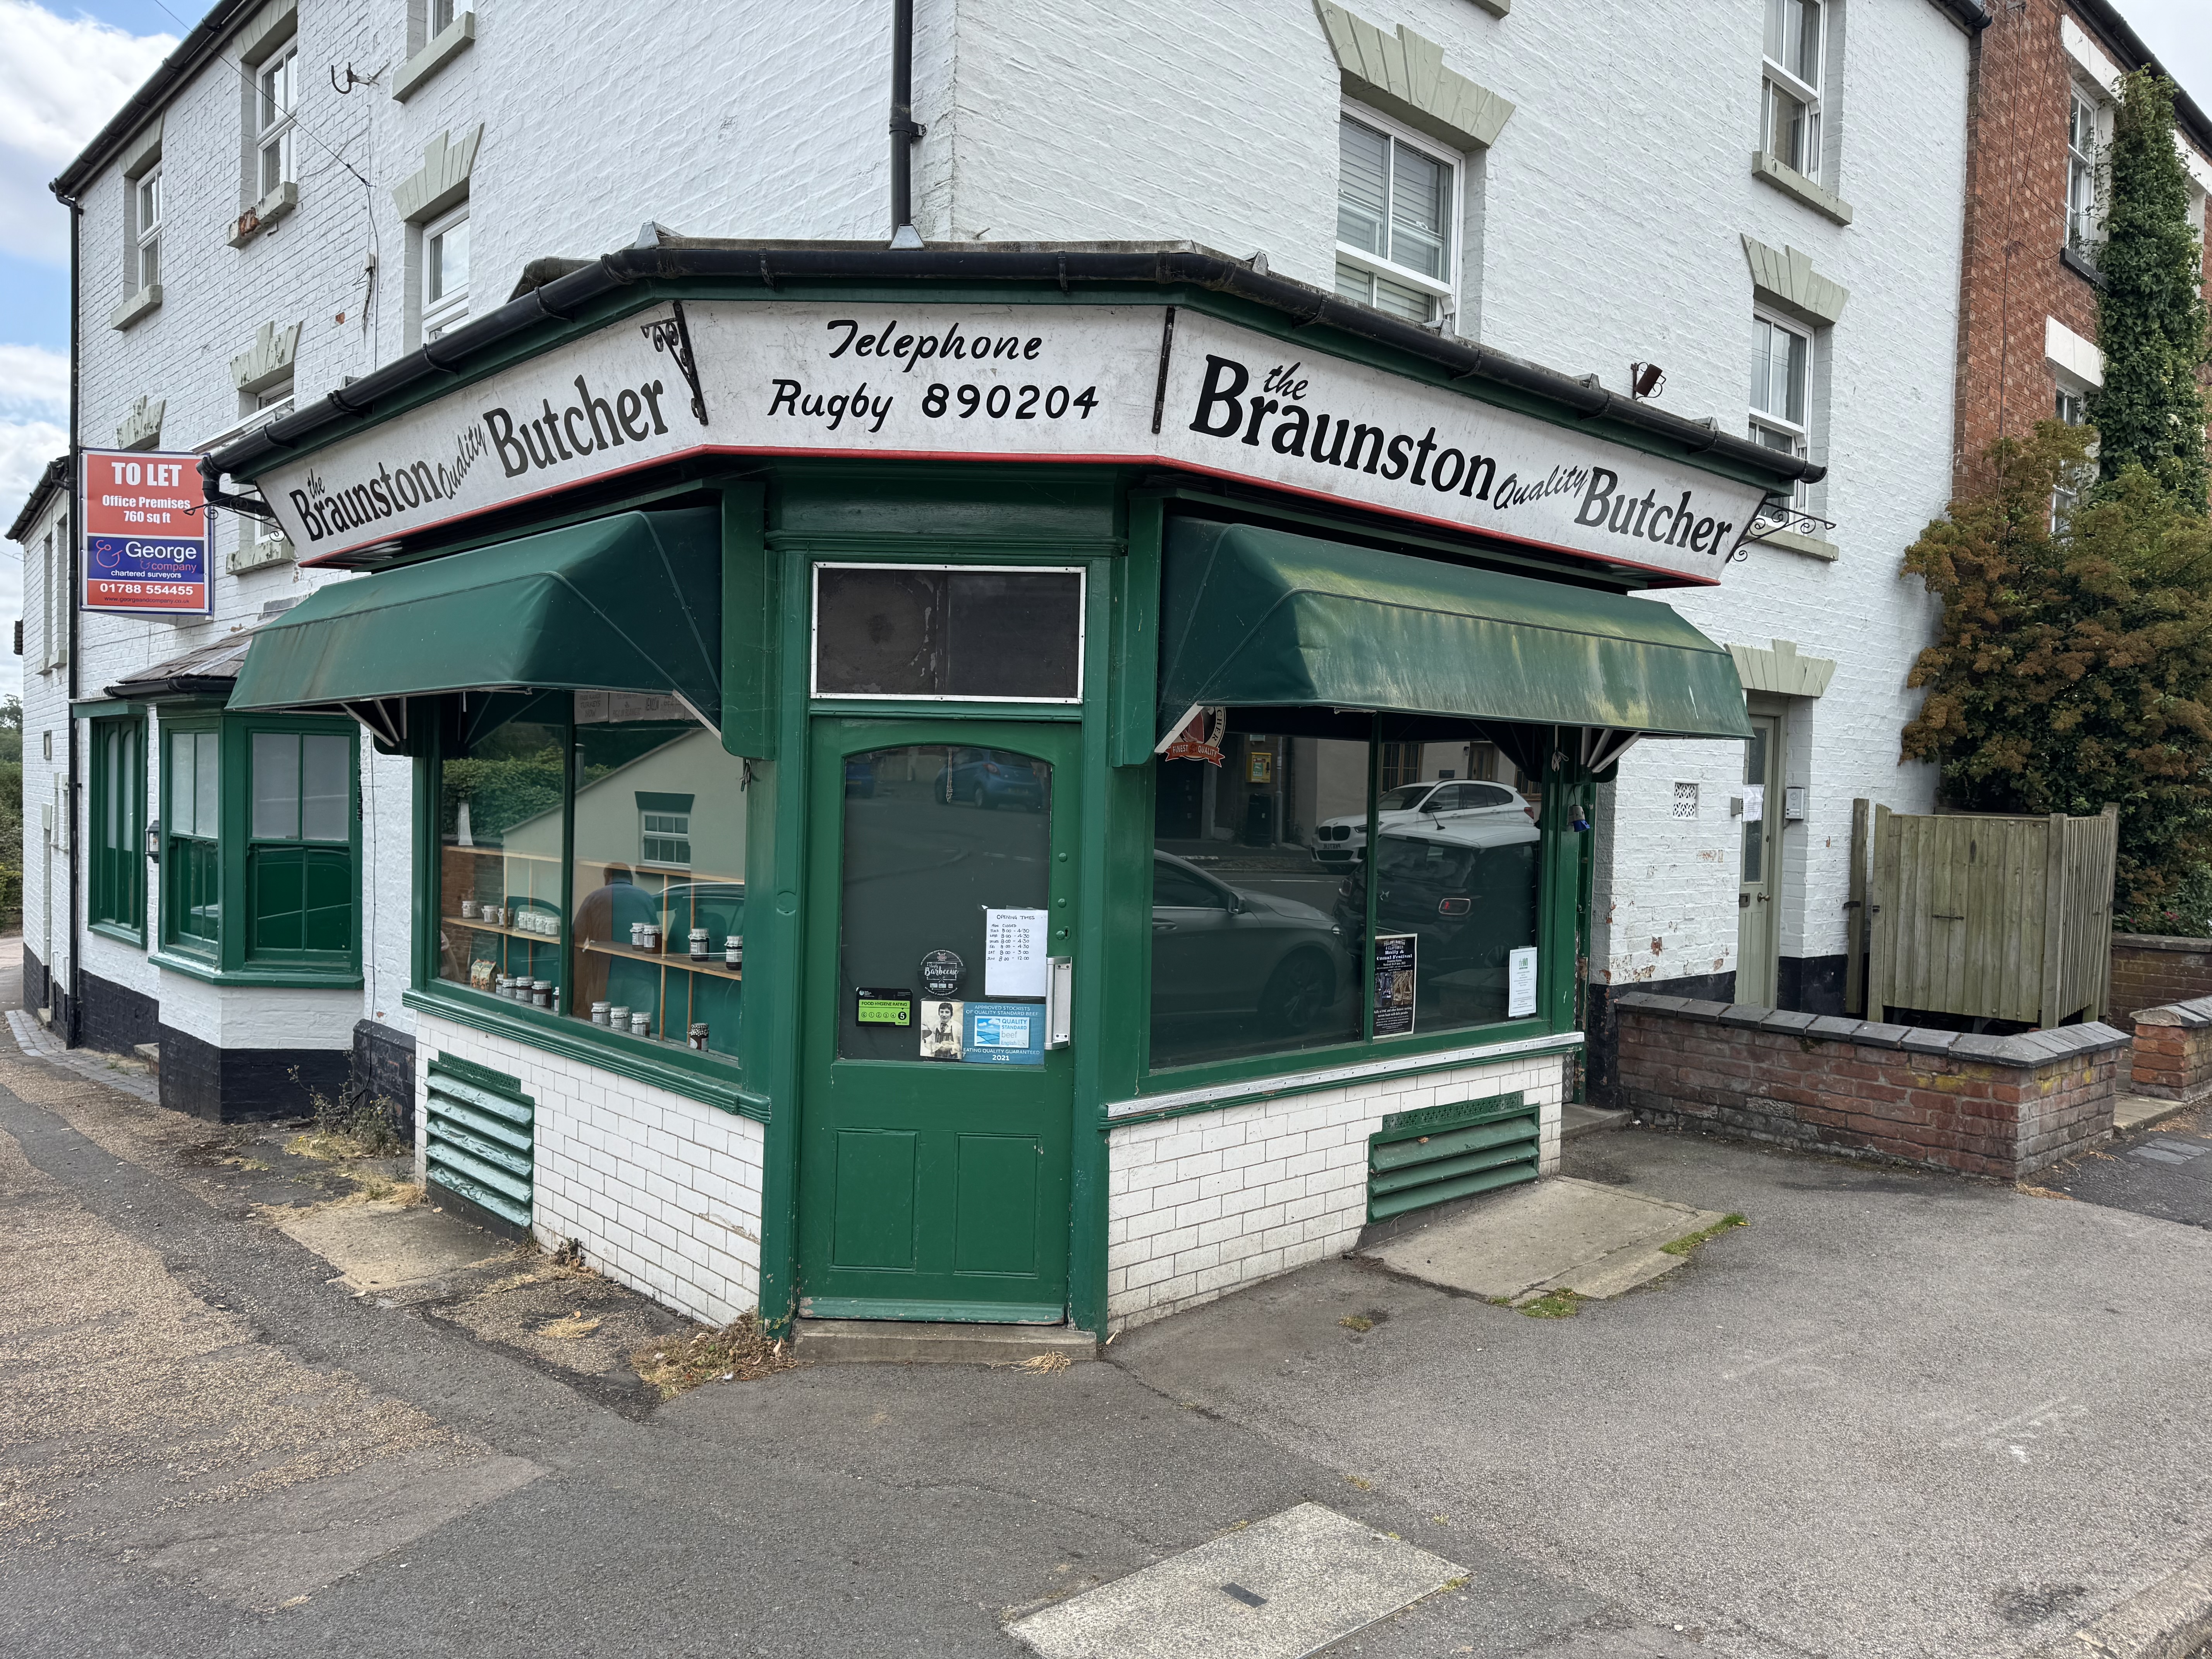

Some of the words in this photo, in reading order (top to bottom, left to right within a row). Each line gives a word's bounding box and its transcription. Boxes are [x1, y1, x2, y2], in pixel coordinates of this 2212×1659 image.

[827, 319, 1042, 373] Telephone
[1264, 362, 1308, 400] the
[767, 379, 893, 433] Rugby
[922, 383, 1099, 419] 890204
[483, 374, 668, 478] Butcher
[1189, 354, 1496, 501] Braunston
[112, 462, 141, 486] TO
[147, 464, 182, 486] LET
[438, 423, 488, 500] Quality
[307, 468, 325, 499] the
[1494, 464, 1588, 510] Quality
[102, 495, 136, 507] Office
[139, 496, 191, 509] Premises
[289, 460, 443, 541] Braunston
[1574, 466, 1732, 555] Butcher
[124, 510, 144, 522] 760
[147, 514, 160, 524] sq
[163, 512, 171, 523] ft
[125, 541, 197, 563] George
[152, 563, 197, 573] company
[100, 583, 141, 594] 01788
[146, 586, 193, 596] 554455
[1212, 709, 1223, 741] CHER
[1173, 744, 1188, 754] FINEST
[1197, 745, 1217, 757] QUALITY
[924, 966, 959, 976] Barbecue
